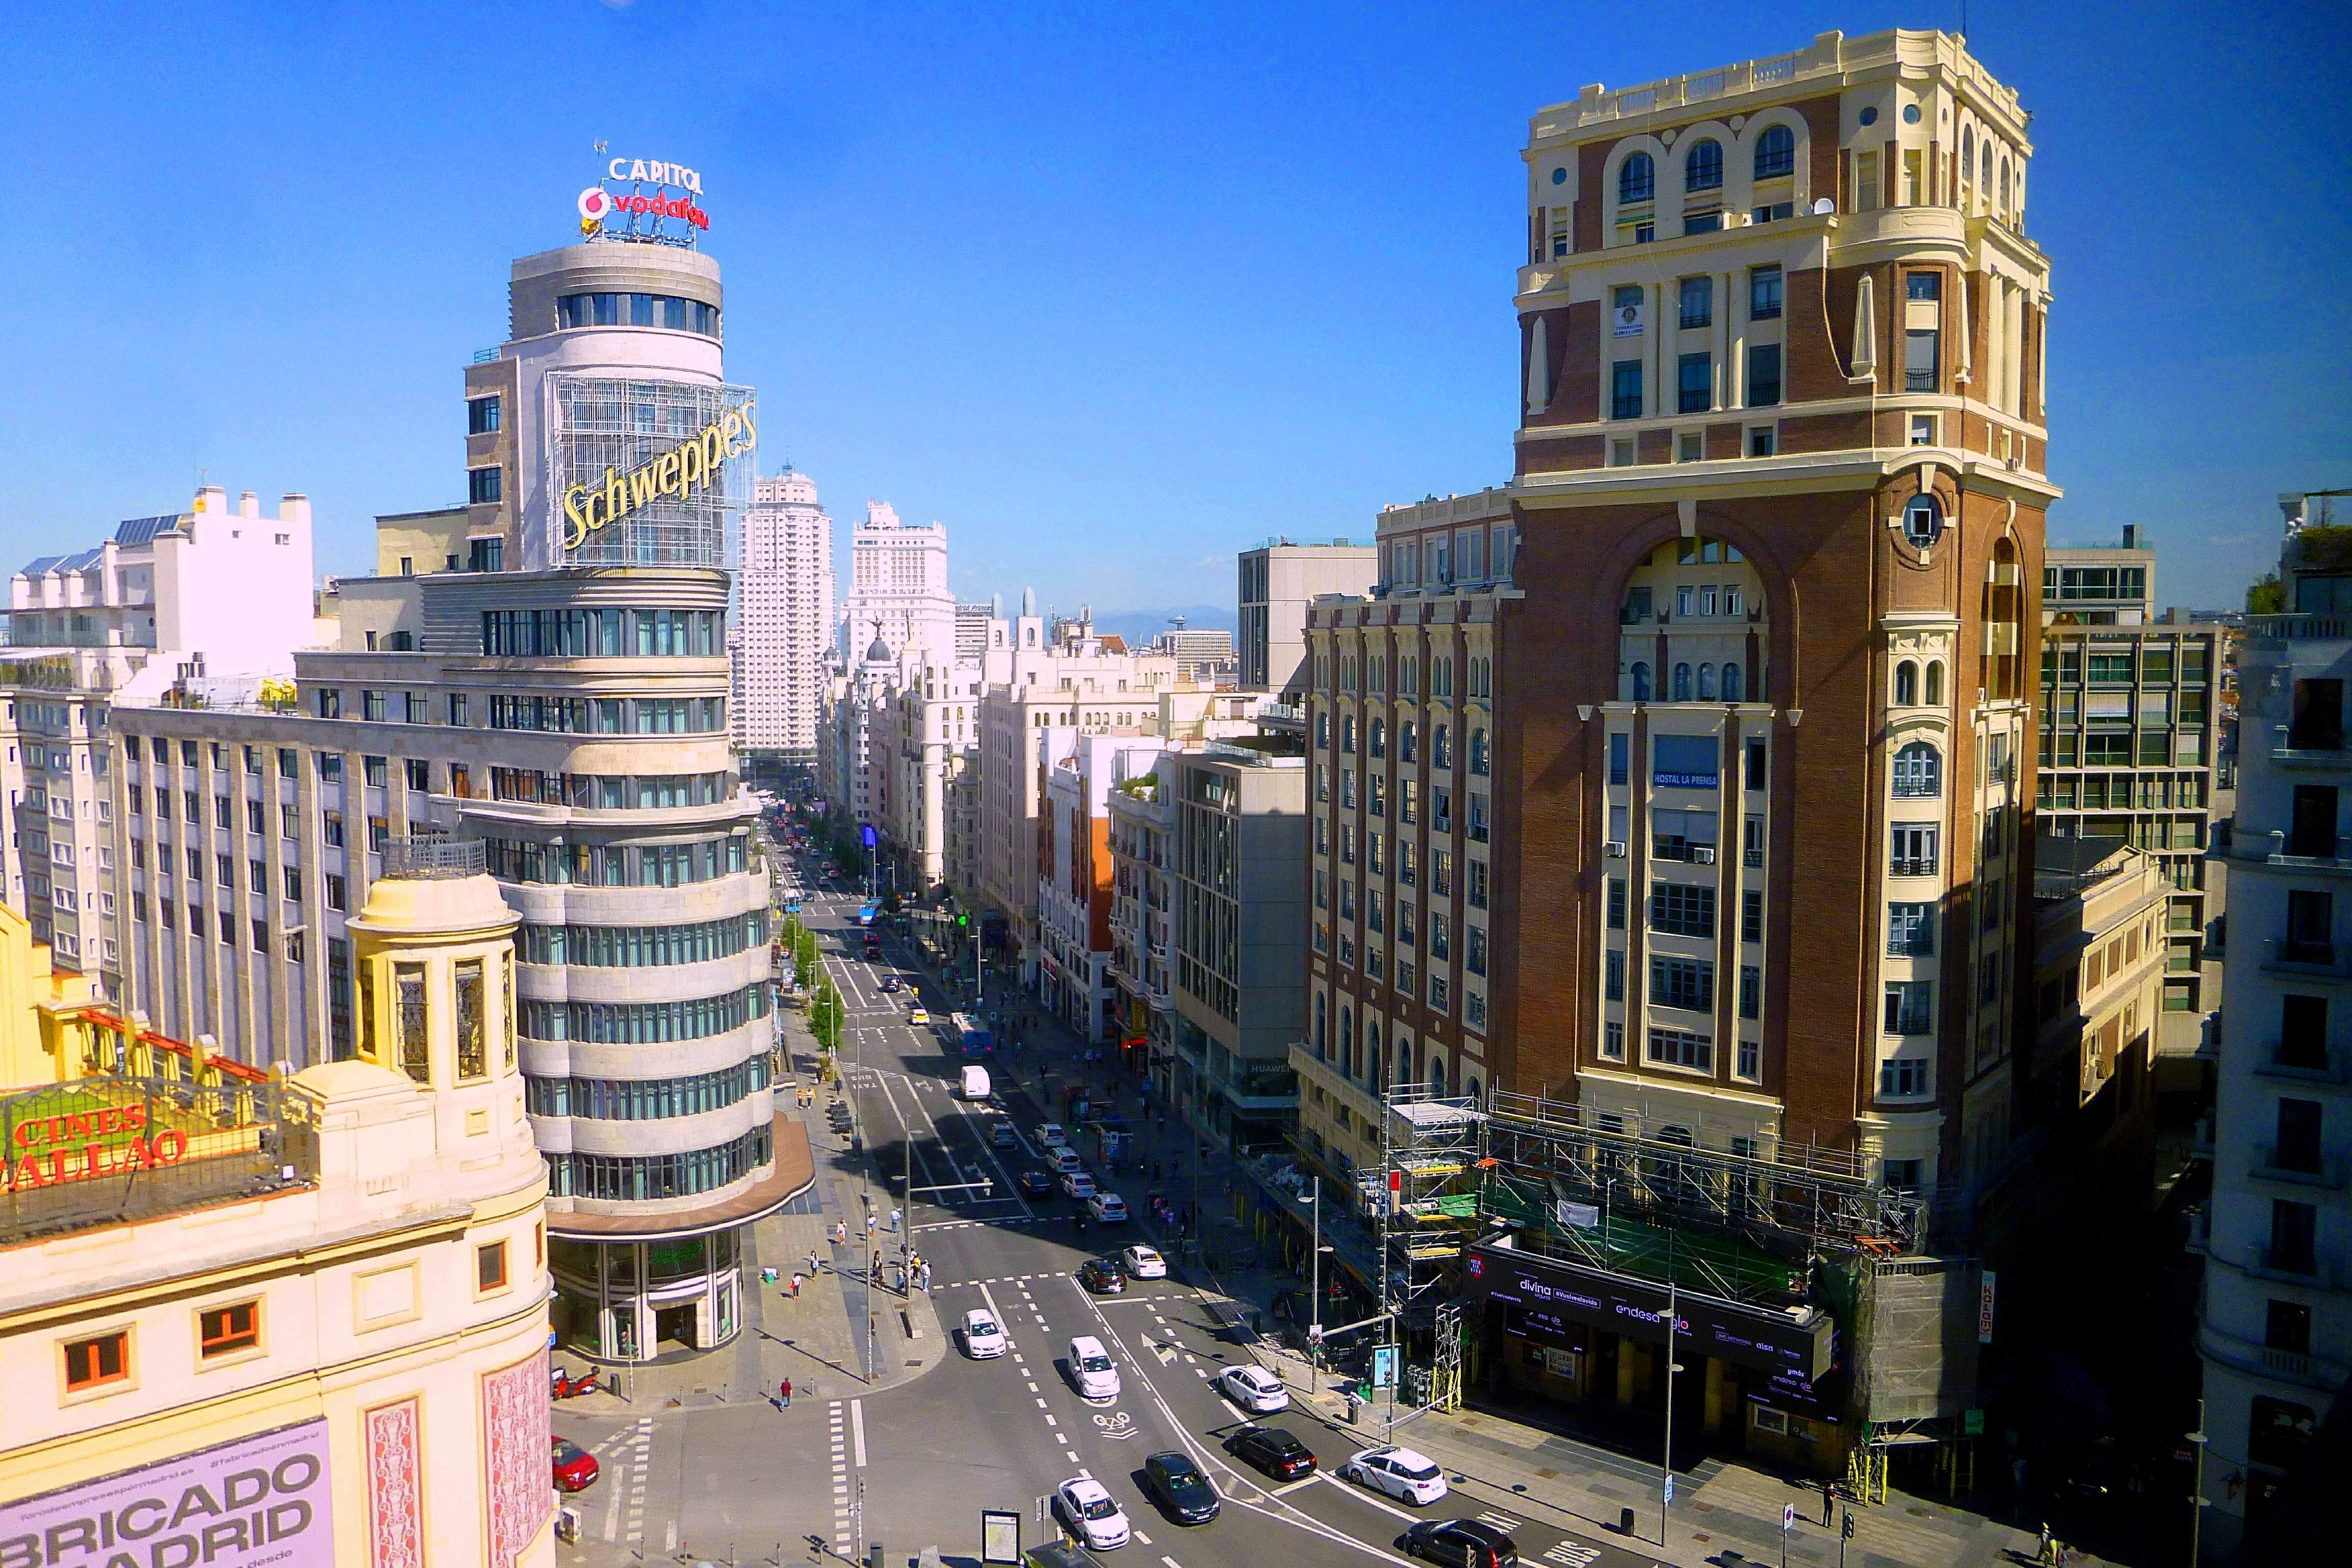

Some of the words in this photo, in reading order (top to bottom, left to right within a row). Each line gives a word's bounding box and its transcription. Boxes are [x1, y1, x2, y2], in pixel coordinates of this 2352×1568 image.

[609, 158, 704, 196] CAPITOL
[564, 400, 756, 550] Schweppes
[1655, 774, 1680, 783] HOSTAL
[1681, 775, 1690, 784] LA
[1692, 776, 1717, 785] PRENSA
[14, 1102, 147, 1147] CINES
[1520, 1280, 1551, 1296] divina
[1555, 1291, 1598, 1307] #Vuelvealavida
[1616, 1305, 1660, 1324] endesa
[1756, 1342, 1774, 1352] alsa
[1543, 1540, 1601, 1568] BUS
